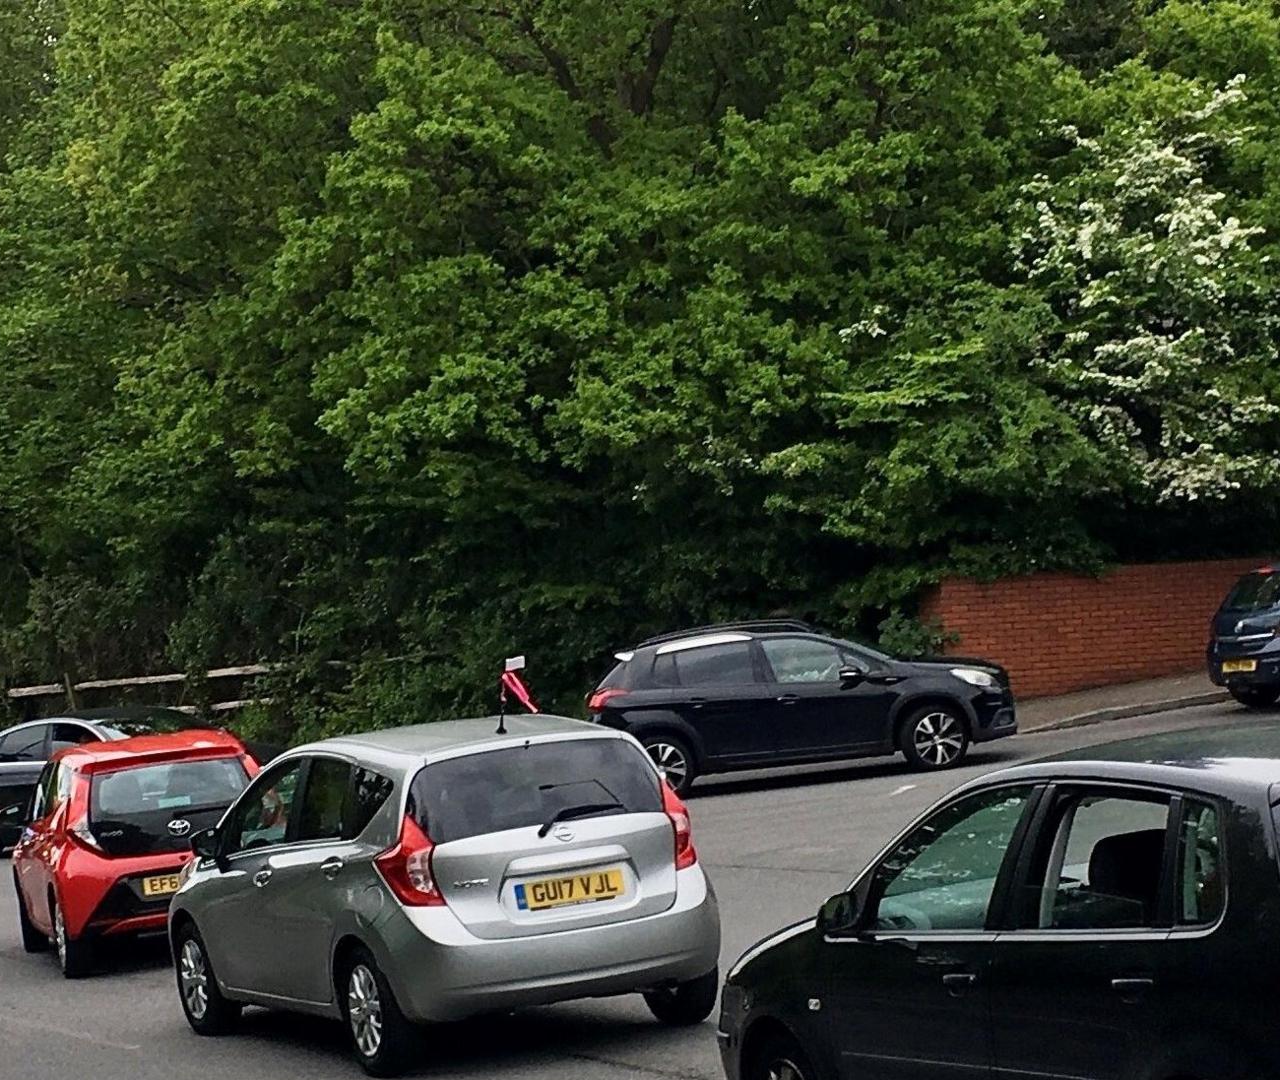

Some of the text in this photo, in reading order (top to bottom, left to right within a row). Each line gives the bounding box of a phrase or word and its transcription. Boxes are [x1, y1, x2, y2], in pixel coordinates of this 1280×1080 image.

[150, 876, 178, 892] EF6
[532, 873, 618, 903] GU17 VJL
